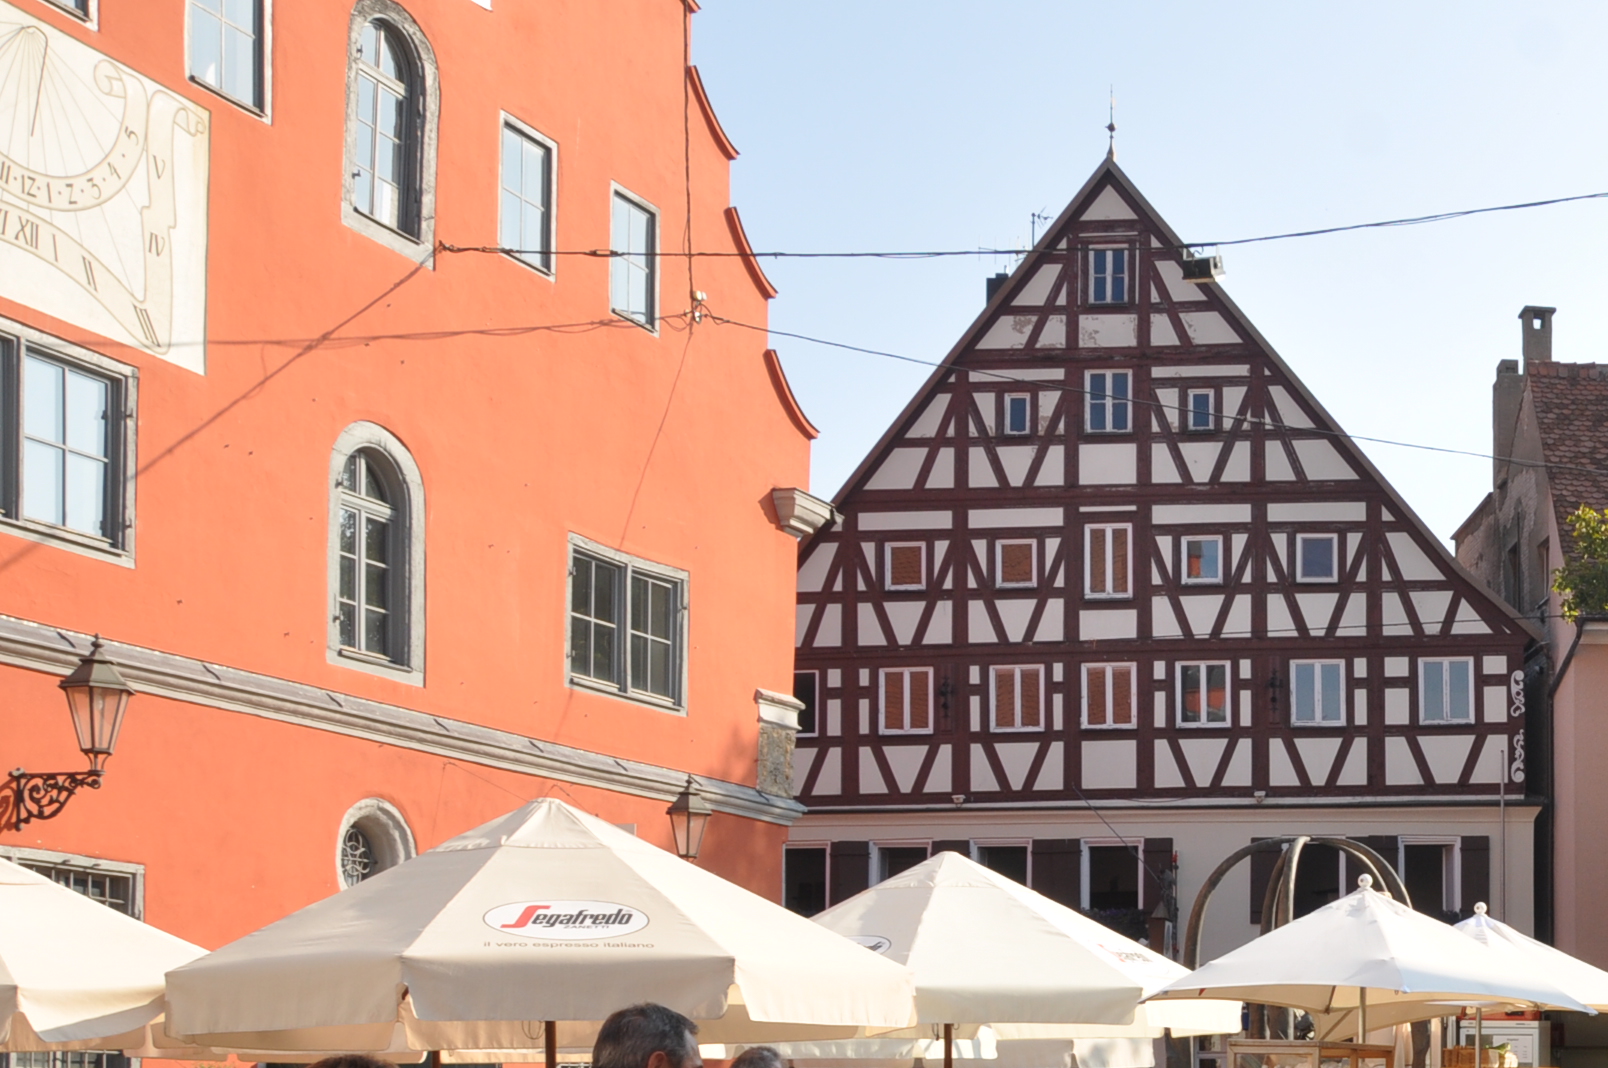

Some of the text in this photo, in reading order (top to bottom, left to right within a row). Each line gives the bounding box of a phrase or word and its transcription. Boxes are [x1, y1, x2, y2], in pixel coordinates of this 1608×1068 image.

[86, 177, 101, 200] 3
[107, 162, 121, 180] 4
[124, 126, 139, 146] 5
[14, 215, 39, 250] XII
[82, 254, 98, 293] II
[132, 304, 162, 348] III
[500, 905, 633, 928] Segafredo
[533, 941, 599, 949] espresso
